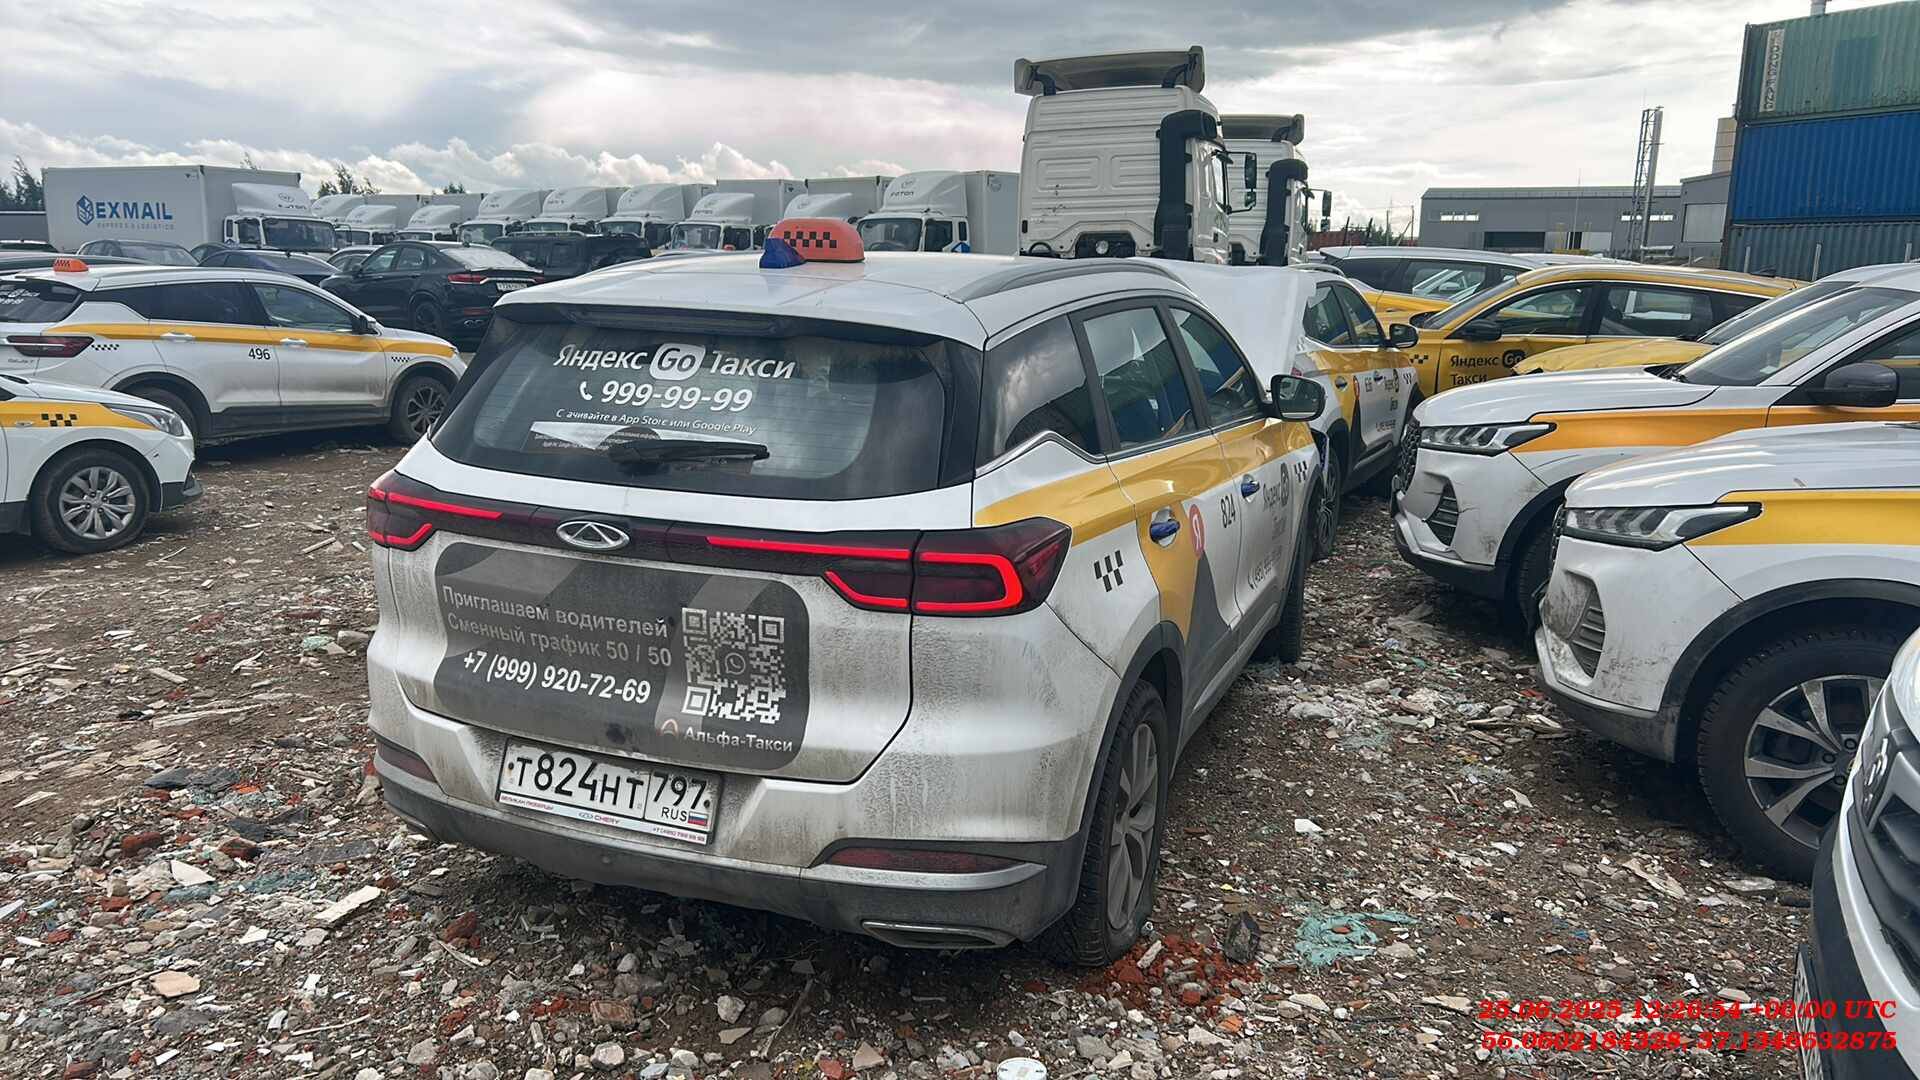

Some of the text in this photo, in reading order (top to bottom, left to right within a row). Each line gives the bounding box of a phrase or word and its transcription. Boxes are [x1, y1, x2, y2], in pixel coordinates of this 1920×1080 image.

[95, 202, 173, 220] EXMAIL
[248, 347, 271, 360] 496
[552, 344, 797, 379] Яндекс Go Такси
[1450, 355, 1499, 367] Яндекс
[1450, 374, 1487, 386] Такси
[600, 380, 753, 412] 999-99-99
[556, 408, 610, 422] Сачивайте
[618, 416, 640, 425] App
[669, 420, 690, 428] или
[692, 420, 731, 433] Google
[733, 424, 758, 434] Play
[1220, 494, 1236, 528] 824
[442, 585, 668, 638] Приглашаем водителей
[447, 612, 526, 645] Сменный
[530, 632, 601, 657] график
[606, 640, 629, 661] 50
[648, 647, 672, 666] 50
[463, 650, 651, 704] +7 (999) 920-72-69
[684, 726, 793, 752] Альфа-Такси
[653, 771, 706, 810] 797
[661, 807, 688, 822] RUS
